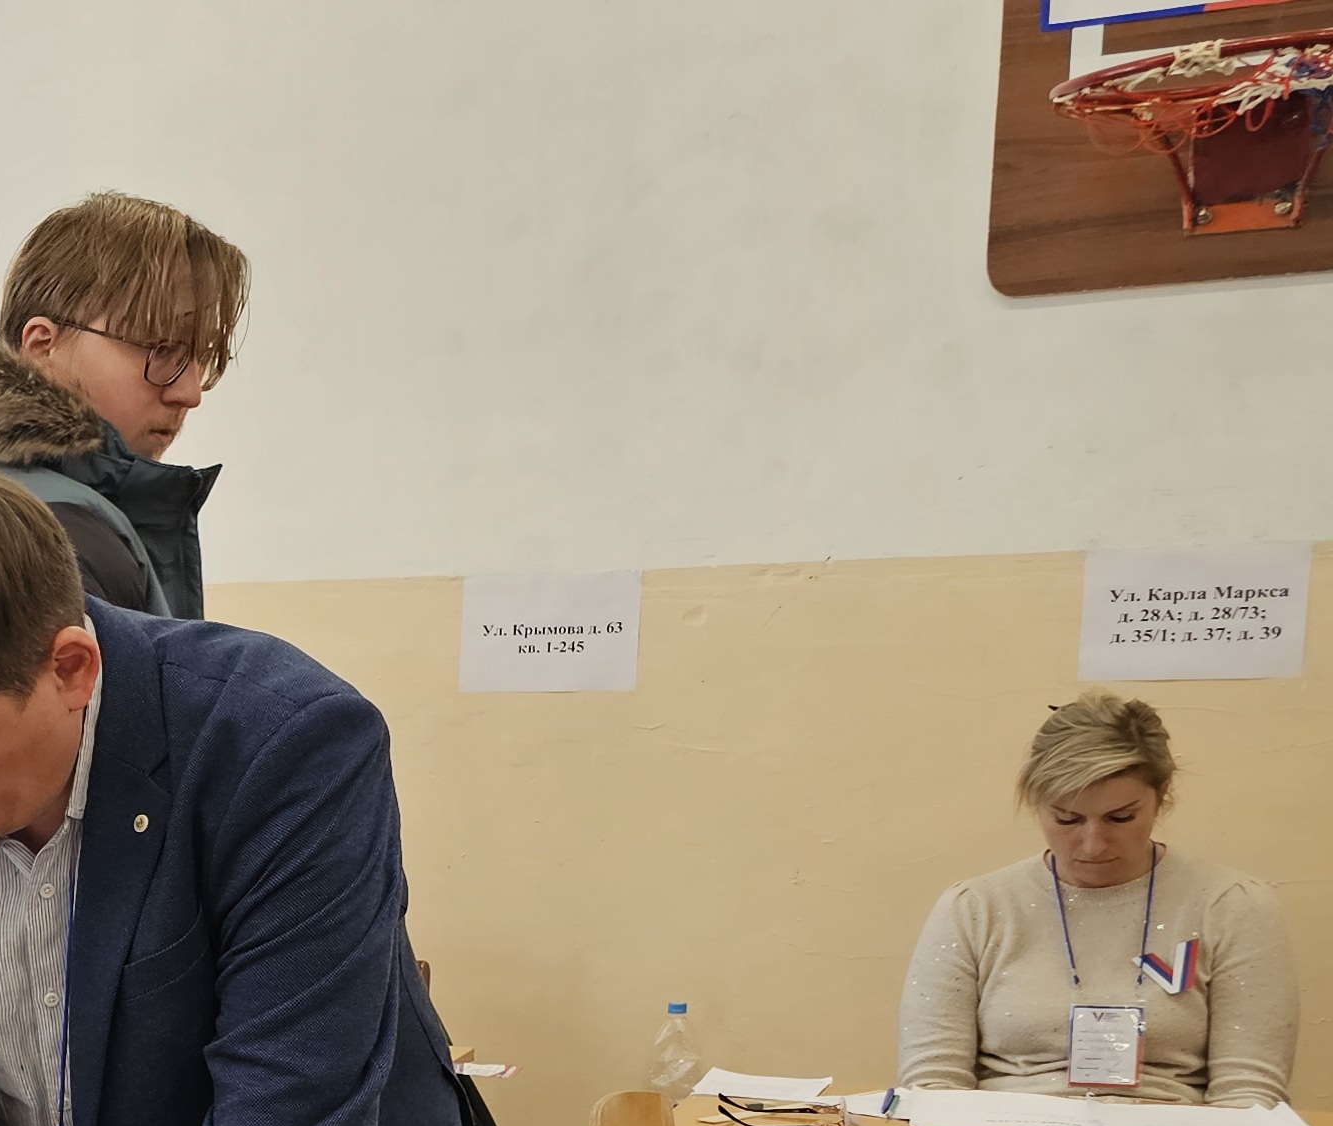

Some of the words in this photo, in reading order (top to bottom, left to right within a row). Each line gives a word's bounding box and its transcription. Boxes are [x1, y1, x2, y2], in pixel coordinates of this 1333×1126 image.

[1109, 588, 1141, 603] Ул.
[1147, 587, 1207, 604] Карла
[1213, 585, 1289, 602] Маркса
[1117, 612, 1134, 624] д.
[1187, 610, 1205, 621] д.
[1210, 605, 1267, 621] 28/73;
[482, 624, 508, 637] Ул.
[513, 623, 584, 638] Крымова
[588, 625, 602, 636] д.
[606, 621, 623, 634] 63
[1109, 633, 1126, 645] д.
[1131, 628, 1176, 644] 35/1;
[1181, 632, 1198, 643] д.
[1203, 627, 1232, 643] 37;
[1236, 630, 1254, 641] д.
[1259, 625, 1282, 640] 39
[518, 644, 541, 654] кв.
[546, 640, 585, 653] 1-245
